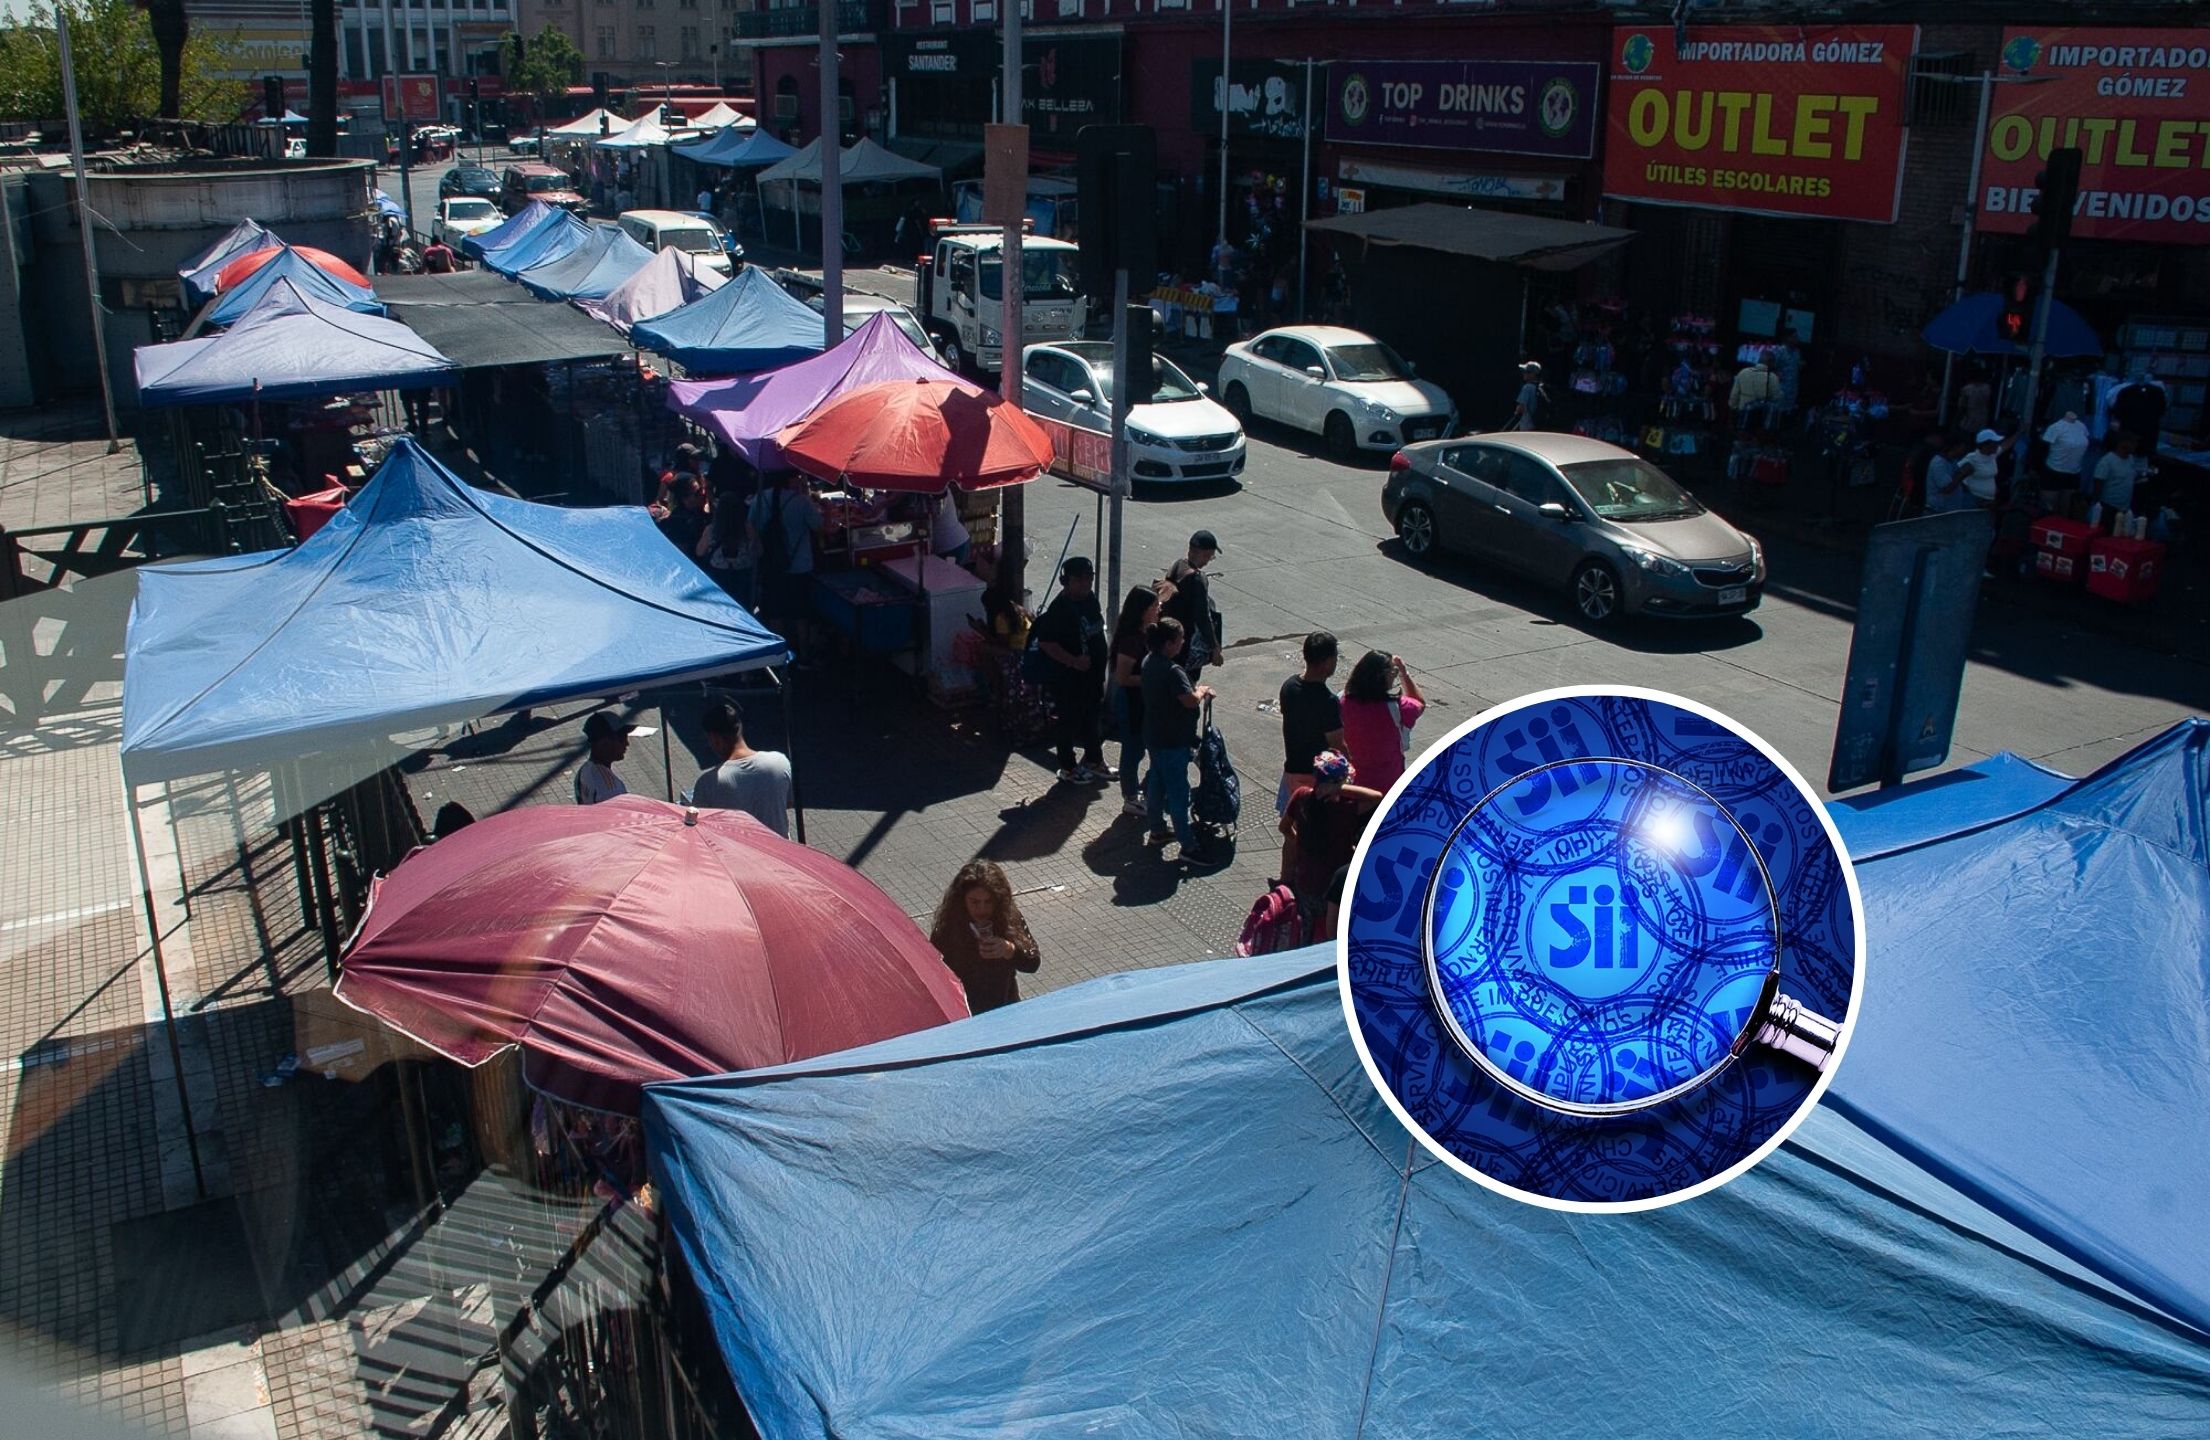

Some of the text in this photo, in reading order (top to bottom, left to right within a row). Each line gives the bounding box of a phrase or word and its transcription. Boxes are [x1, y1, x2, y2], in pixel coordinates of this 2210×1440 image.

[908, 54, 958, 72] SANTANDER
[1812, 36, 1884, 63] GÓMEZ
[2050, 45, 2210, 69] IMPORTADO
[1381, 82, 1526, 114] TOP DRINKS
[2097, 71, 2188, 97] GÓMEZ
[1627, 87, 1880, 161] OUTLET
[1645, 160, 1831, 198] ÚTILES ESCOLARES
[1985, 186, 2210, 224] BIEVENIDOS
